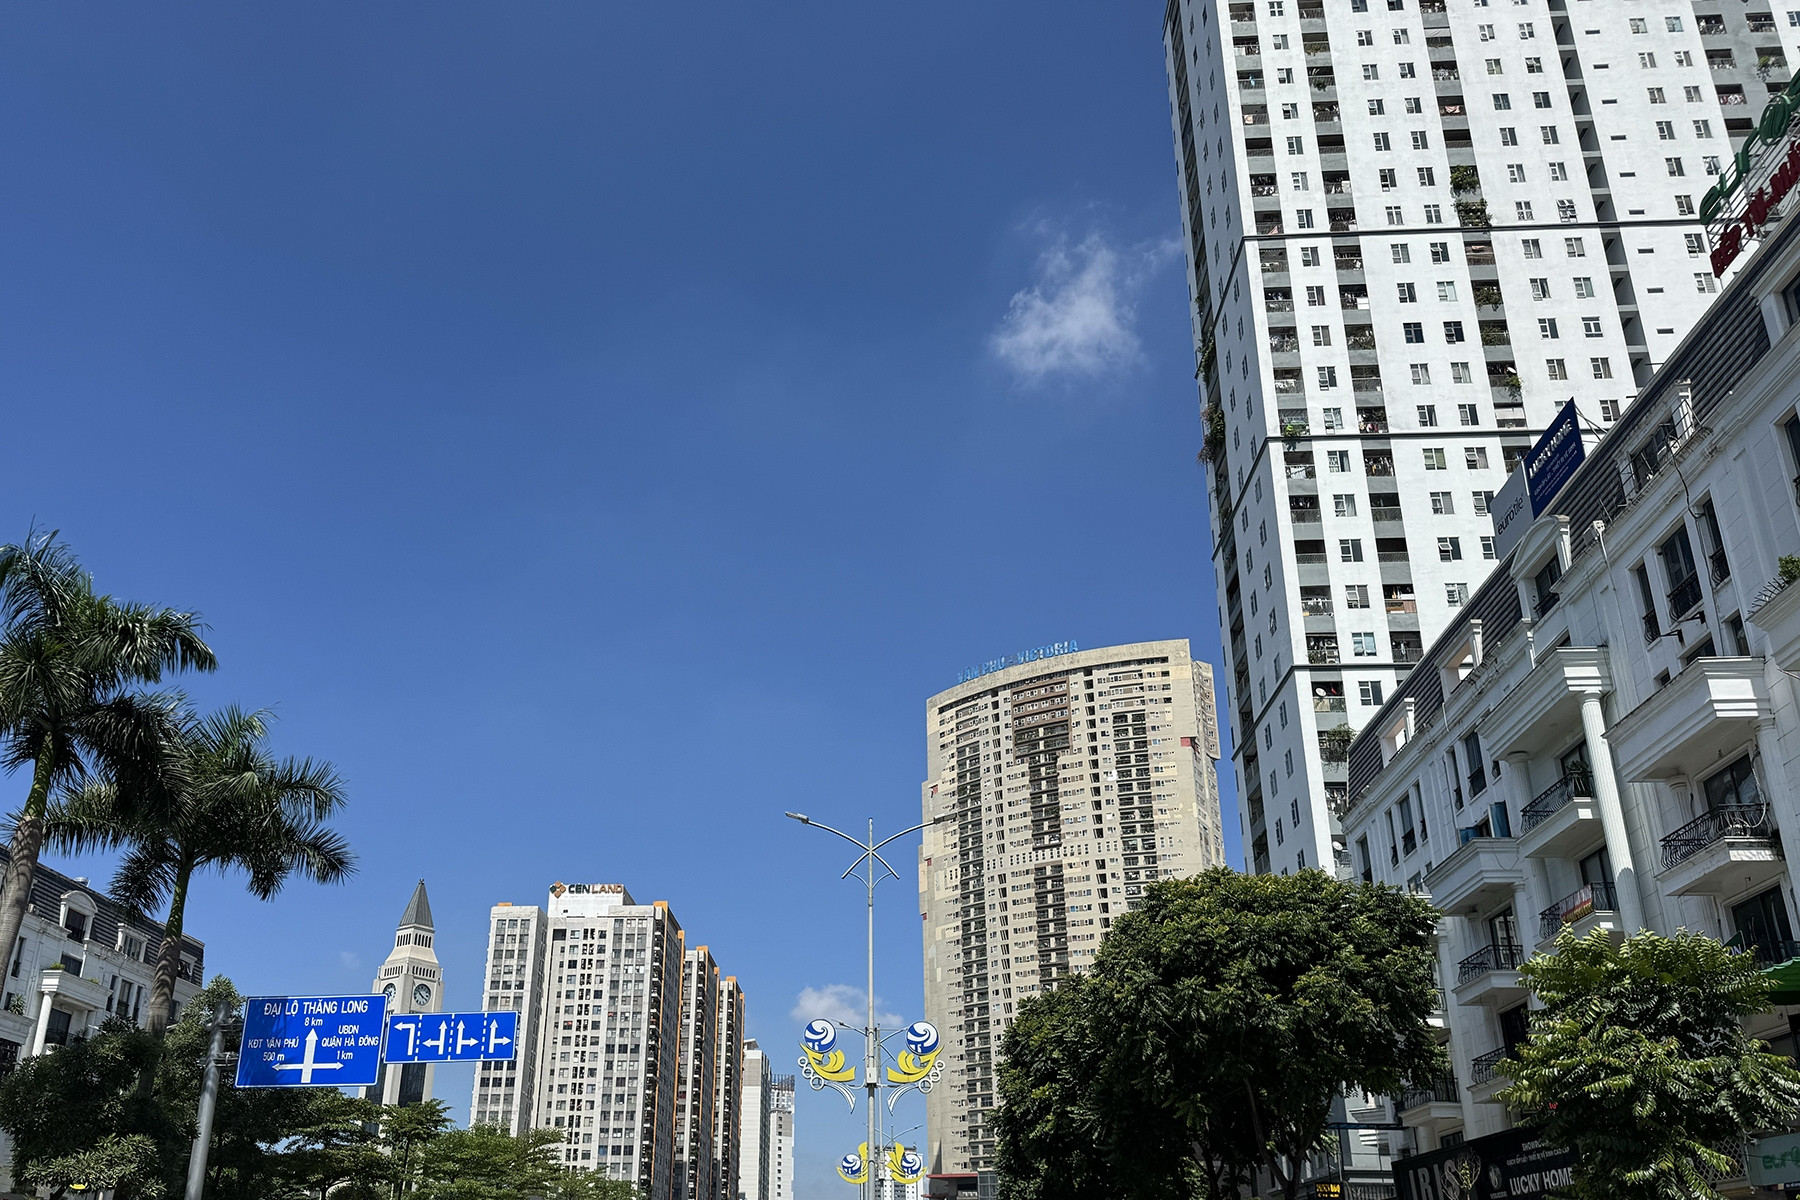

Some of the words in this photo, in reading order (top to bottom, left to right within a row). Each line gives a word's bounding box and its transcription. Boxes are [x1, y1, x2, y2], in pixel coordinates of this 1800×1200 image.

[1016, 639, 1079, 664] VICTORIA
[264, 1001, 282, 1017] ĐẠI
[285, 1000, 299, 1017] LỘ
[303, 999, 338, 1015] THĂNG
[341, 1000, 369, 1013] LONG
[304, 1017, 310, 1026] 8
[311, 1017, 323, 1026] km
[248, 1039, 263, 1048] KĐT
[266, 1038, 281, 1048] VĂN
[283, 1036, 300, 1048] PHÚ
[321, 1036, 342, 1049] QUẬN
[344, 1035, 355, 1046] HÀ
[358, 1035, 379, 1046] ĐÔNG
[263, 1052, 276, 1061] 500
[277, 1053, 285, 1061] m
[341, 1051, 353, 1060] km
[1509, 1173, 1540, 1196] LUCKY
[1542, 1167, 1575, 1190] HOME
